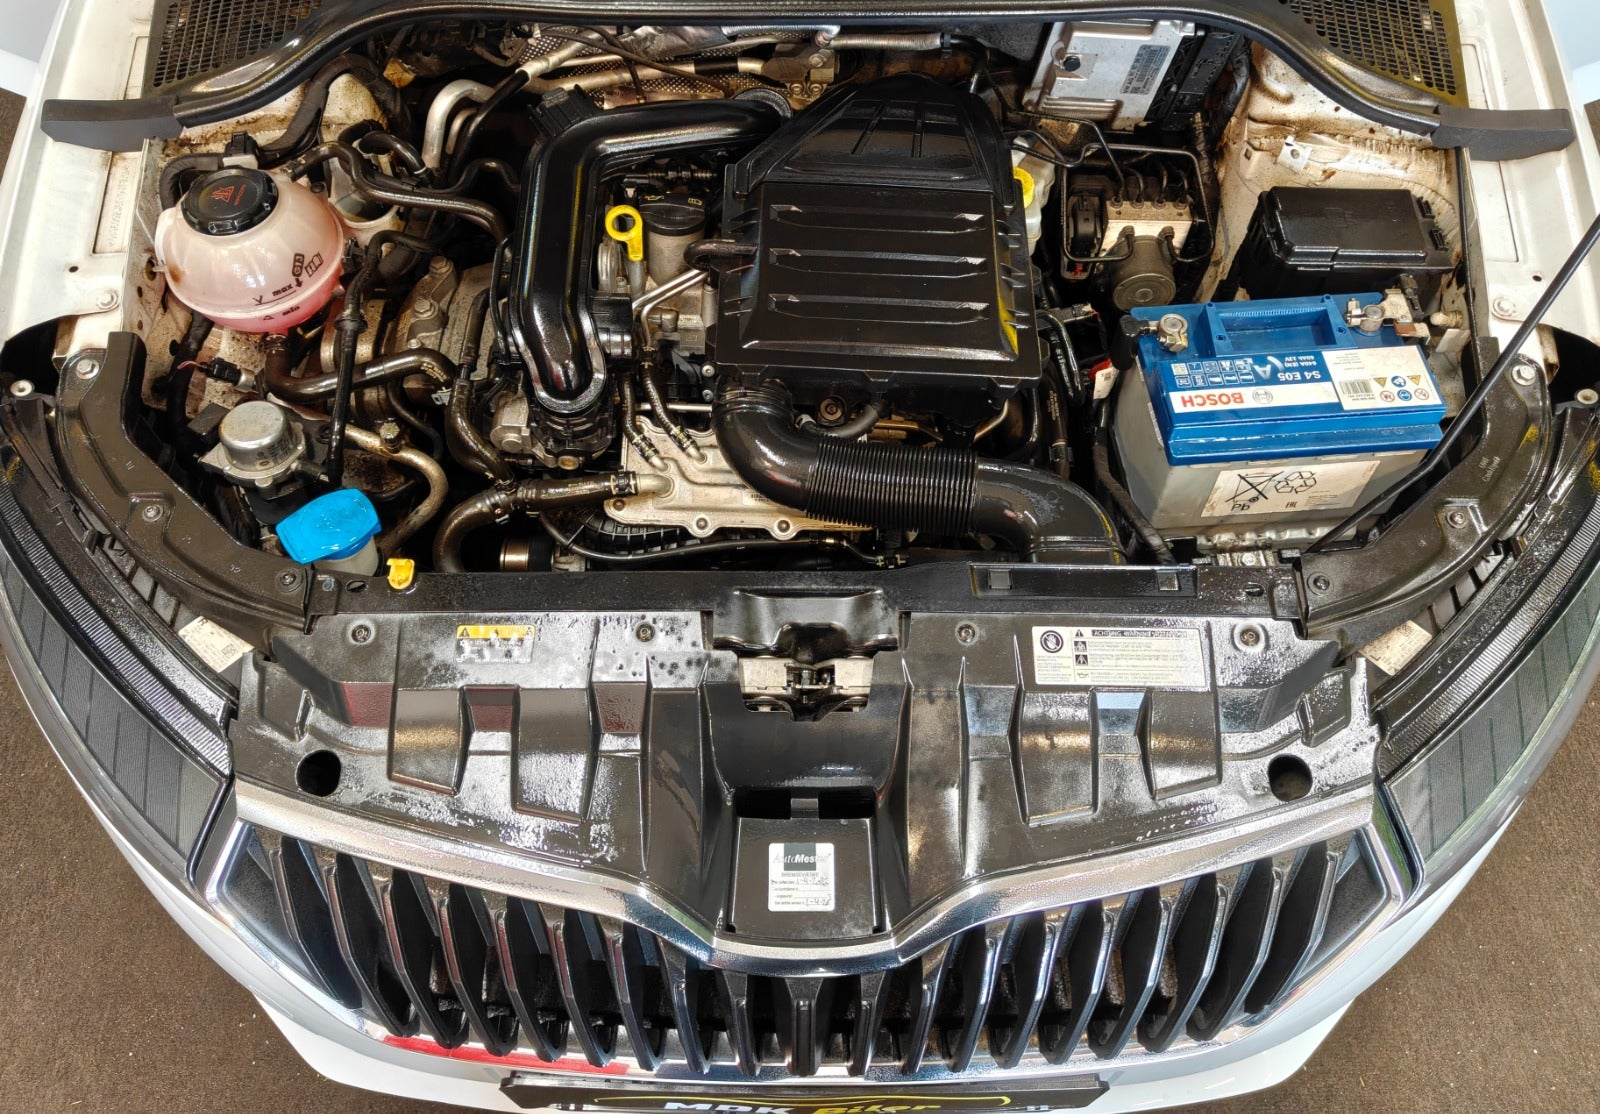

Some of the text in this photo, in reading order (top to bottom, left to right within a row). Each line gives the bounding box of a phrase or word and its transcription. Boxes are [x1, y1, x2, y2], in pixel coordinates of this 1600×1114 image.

[293, 254, 303, 276] G13
[272, 284, 293, 296] max
[282, 306, 300, 316] min
[1277, 371, 1321, 381] S4 E05
[1180, 392, 1244, 407] BOSCH
[1230, 503, 1250, 511] Pb
